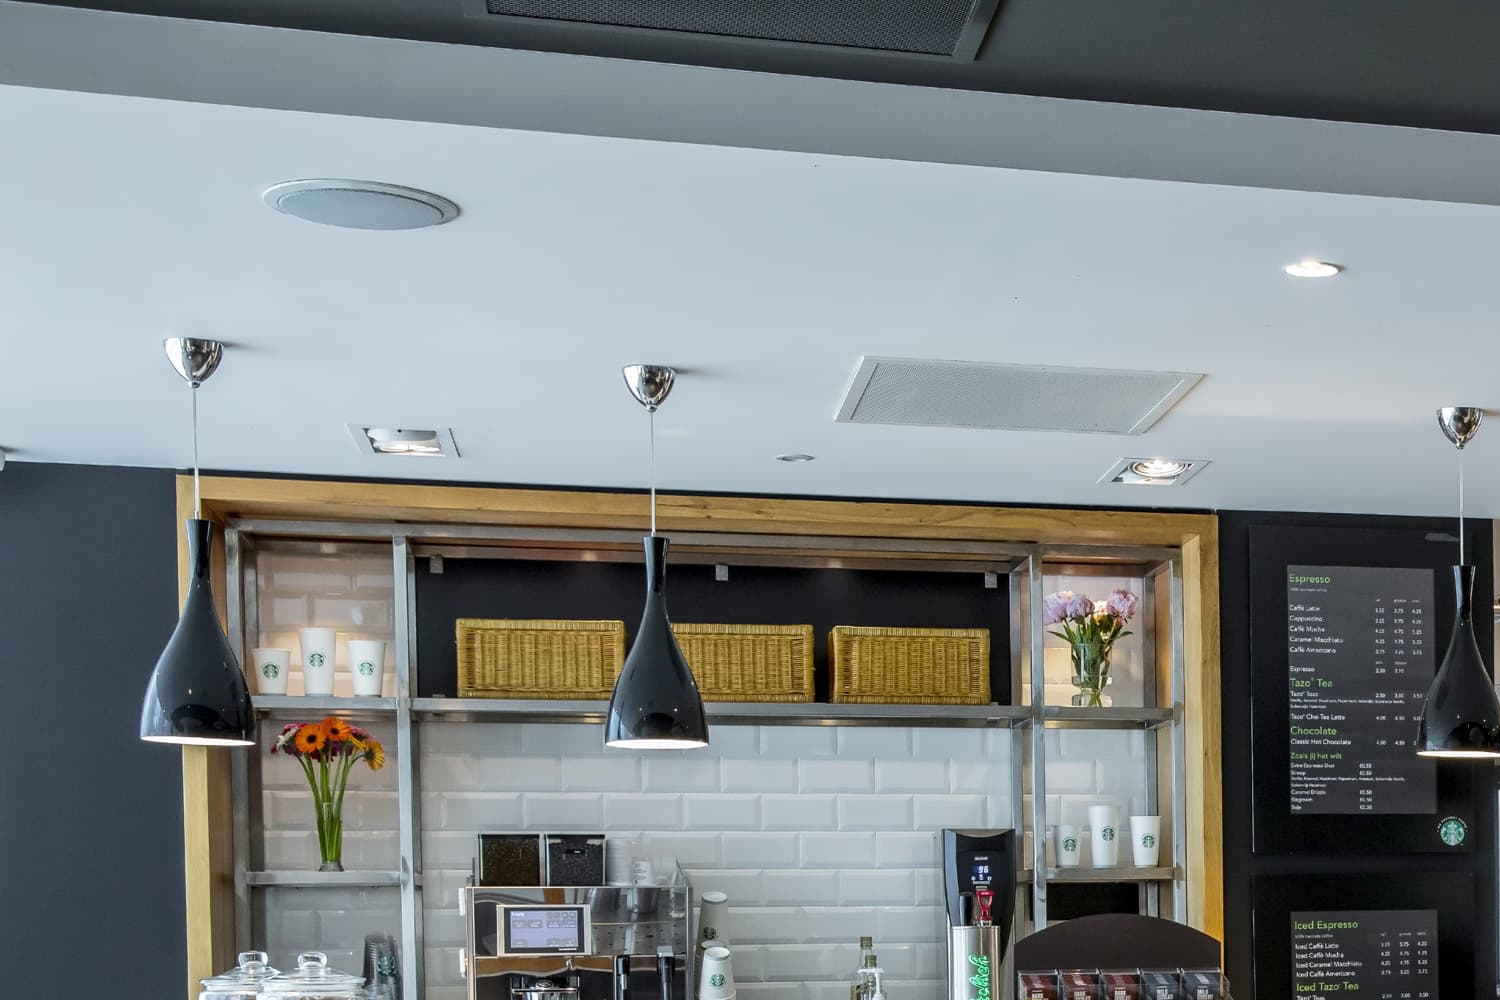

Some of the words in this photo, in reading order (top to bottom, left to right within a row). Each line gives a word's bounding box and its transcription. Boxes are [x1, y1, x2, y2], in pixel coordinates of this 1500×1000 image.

[1289, 573, 1330, 585] Espresso
[1316, 678, 1333, 687] Tea
[1290, 726, 1337, 736] Chocolate
[1295, 920, 1314, 930] Iced
[1317, 920, 1358, 931] Espresso
[1296, 982, 1316, 992] Iced
[1342, 982, 1359, 990] Tea
